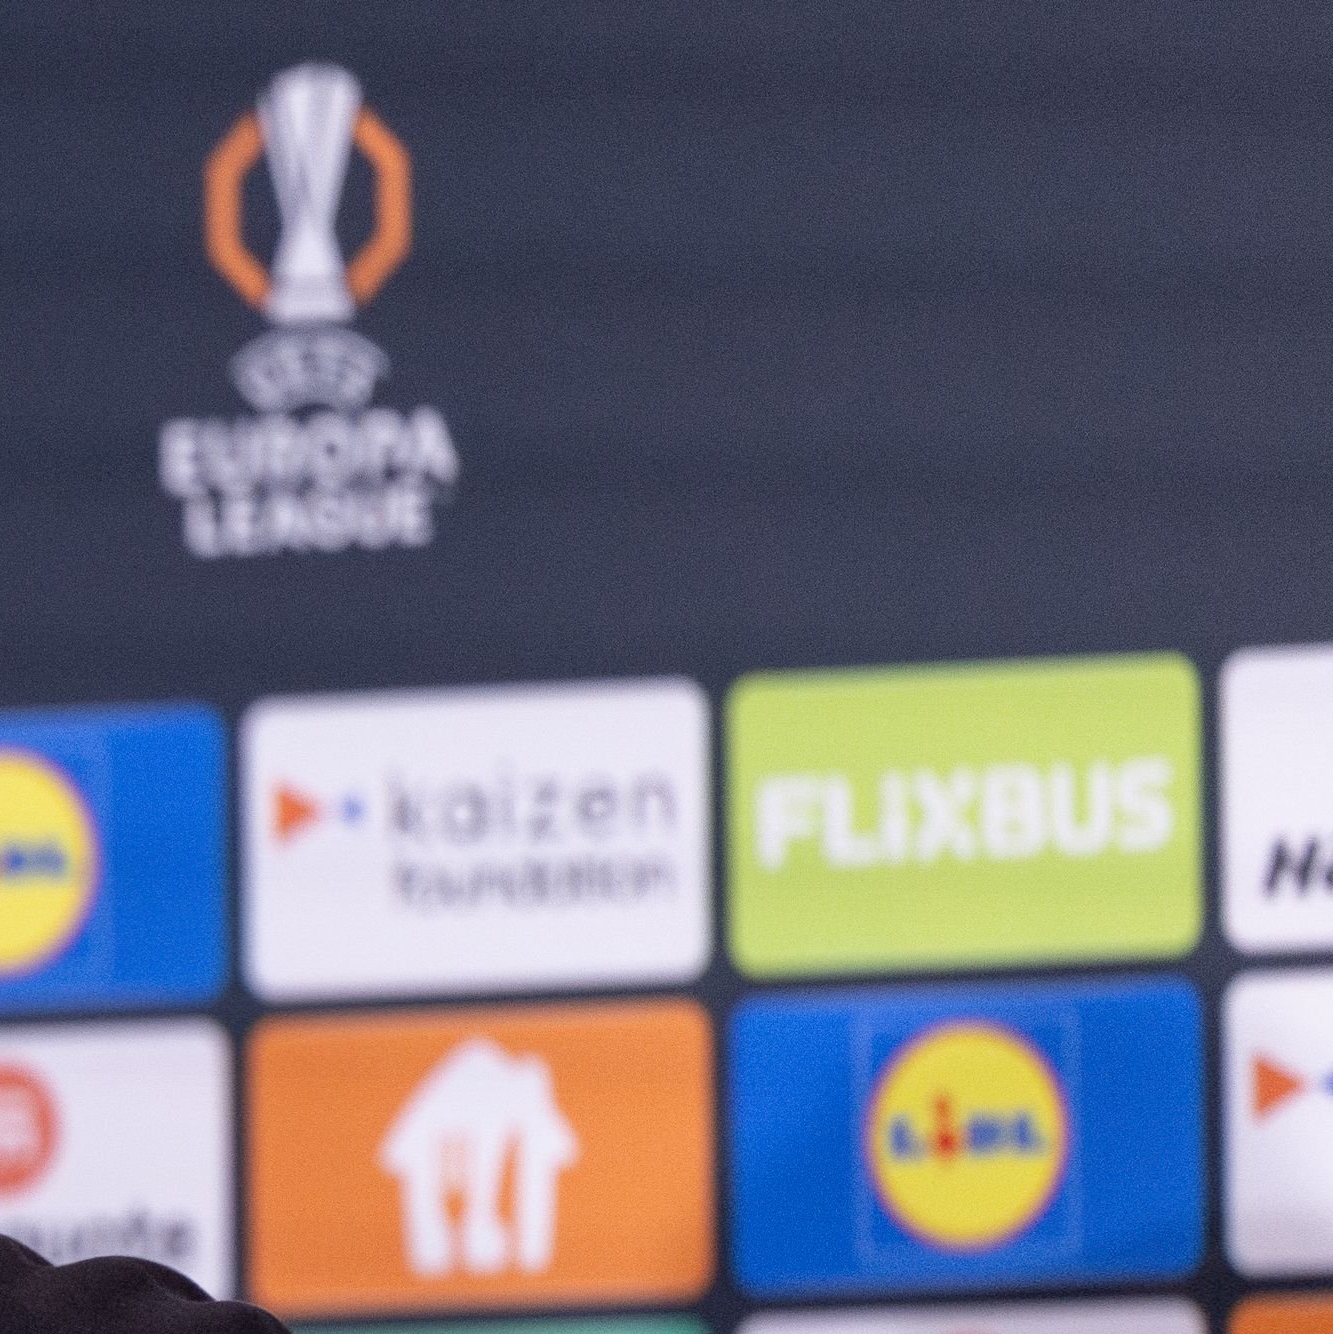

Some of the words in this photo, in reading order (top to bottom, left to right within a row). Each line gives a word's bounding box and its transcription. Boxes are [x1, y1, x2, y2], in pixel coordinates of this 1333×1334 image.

[162, 410, 456, 497] EUROPA
[188, 490, 430, 556] LEAGUE
[387, 766, 678, 845] kaizen
[757, 758, 1174, 870] FLIXBUS
